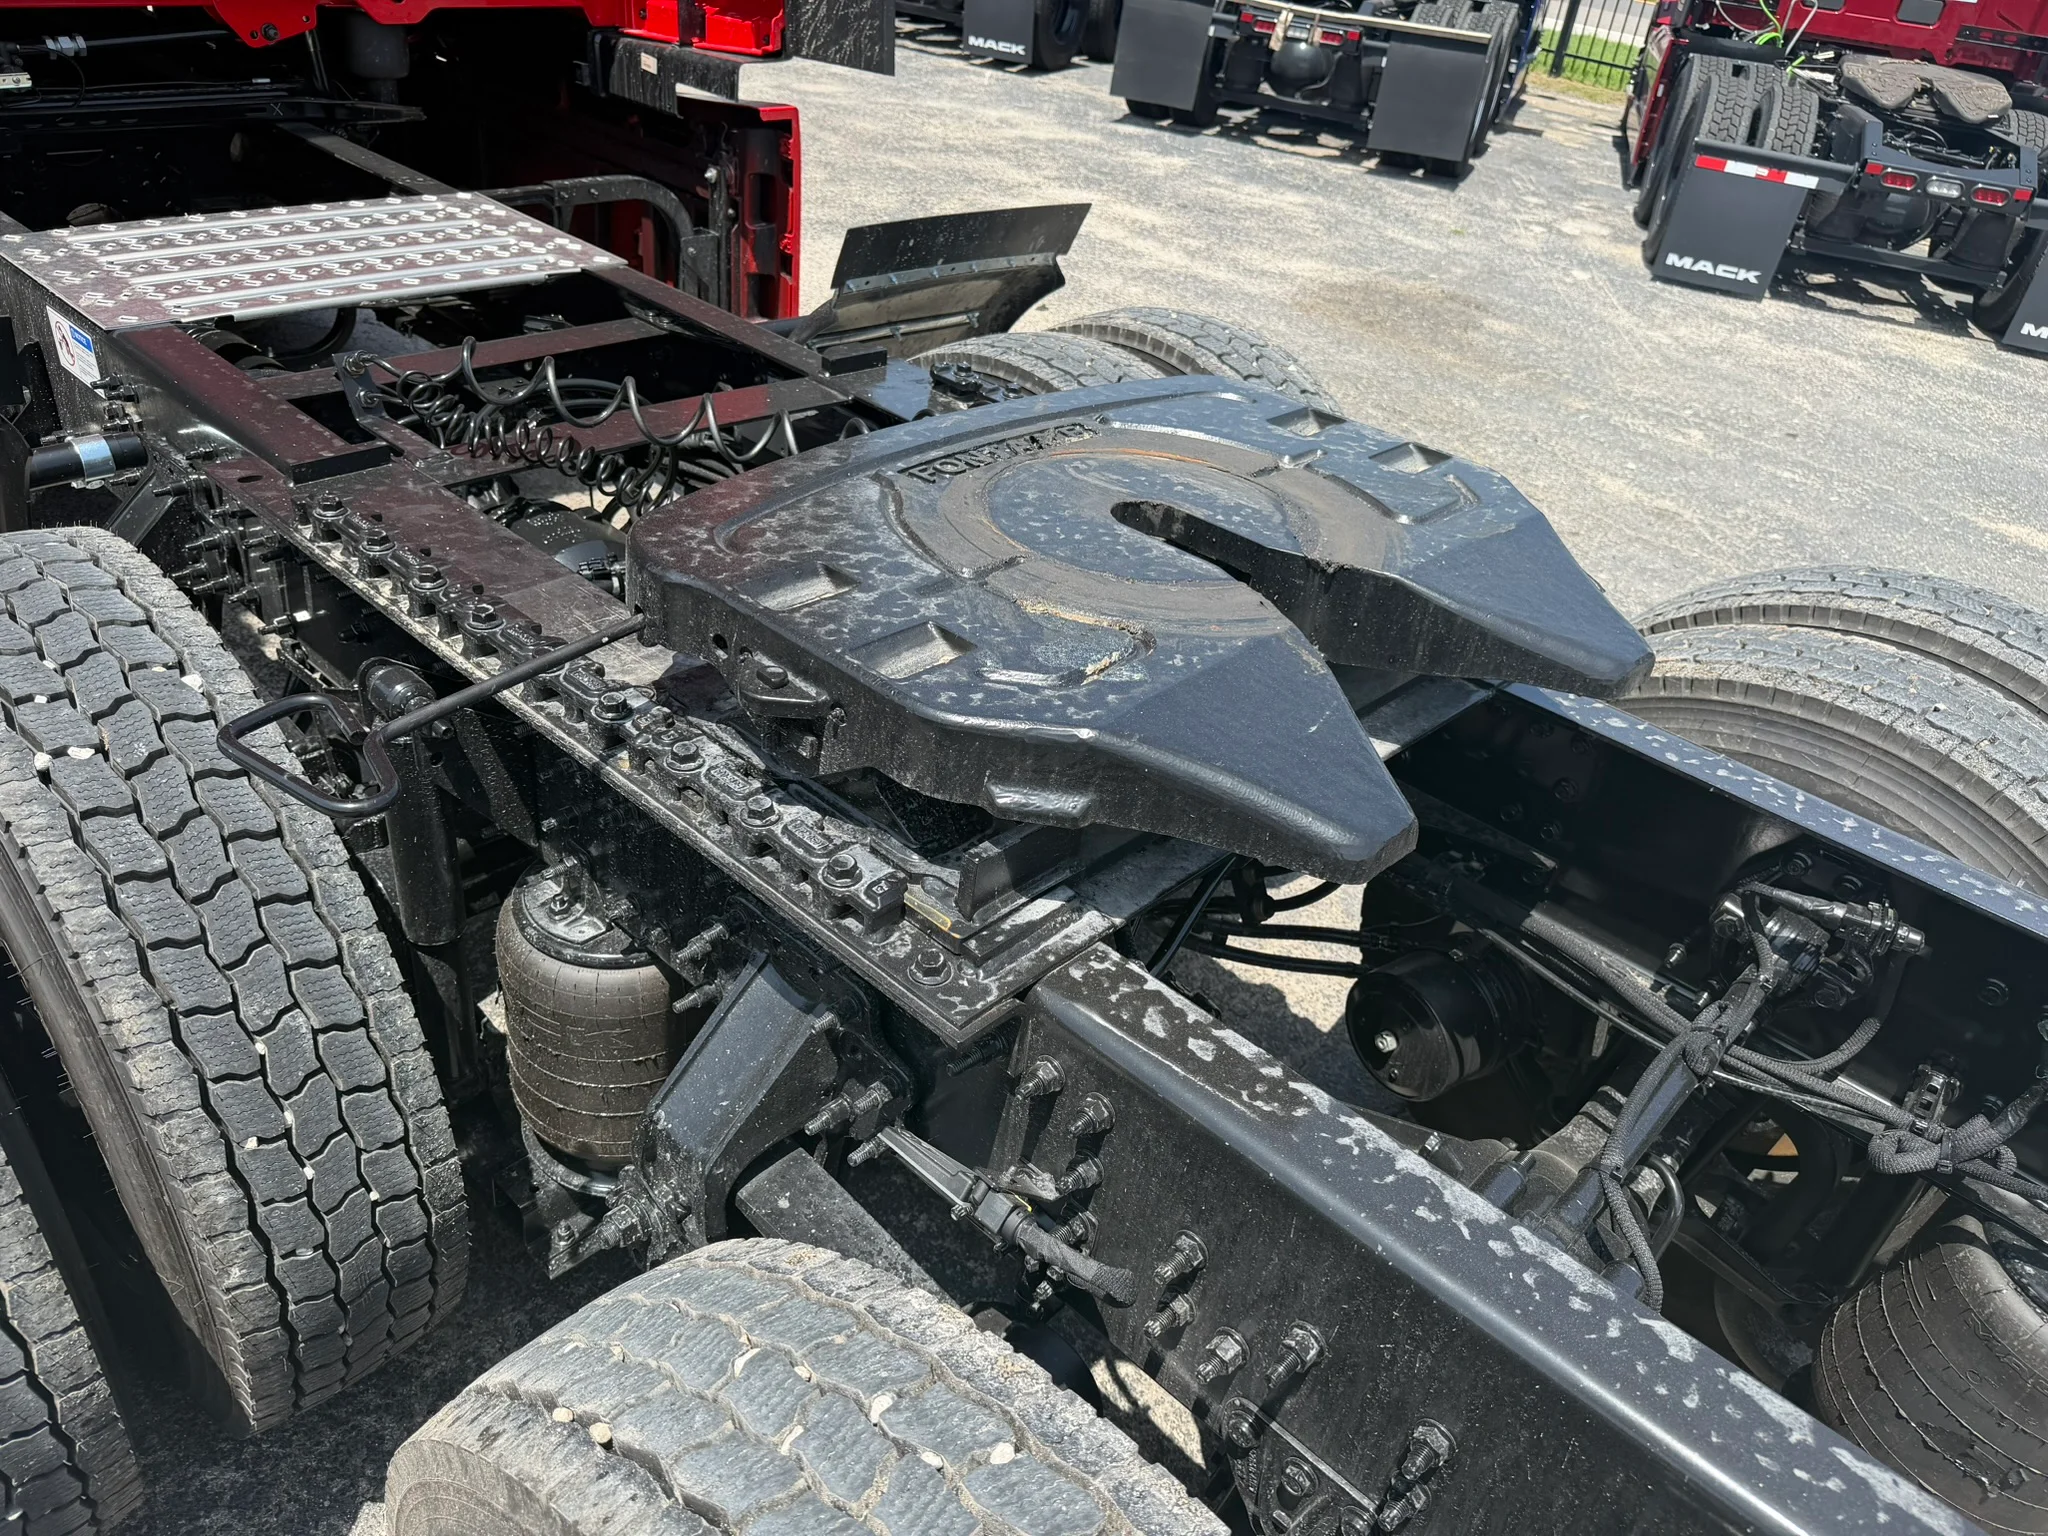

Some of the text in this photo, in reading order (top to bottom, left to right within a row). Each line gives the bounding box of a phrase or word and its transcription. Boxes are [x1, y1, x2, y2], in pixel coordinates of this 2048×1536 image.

[968, 35, 1026, 55] MACK
[1665, 252, 1762, 284] MACK
[2020, 322, 2048, 339] M
